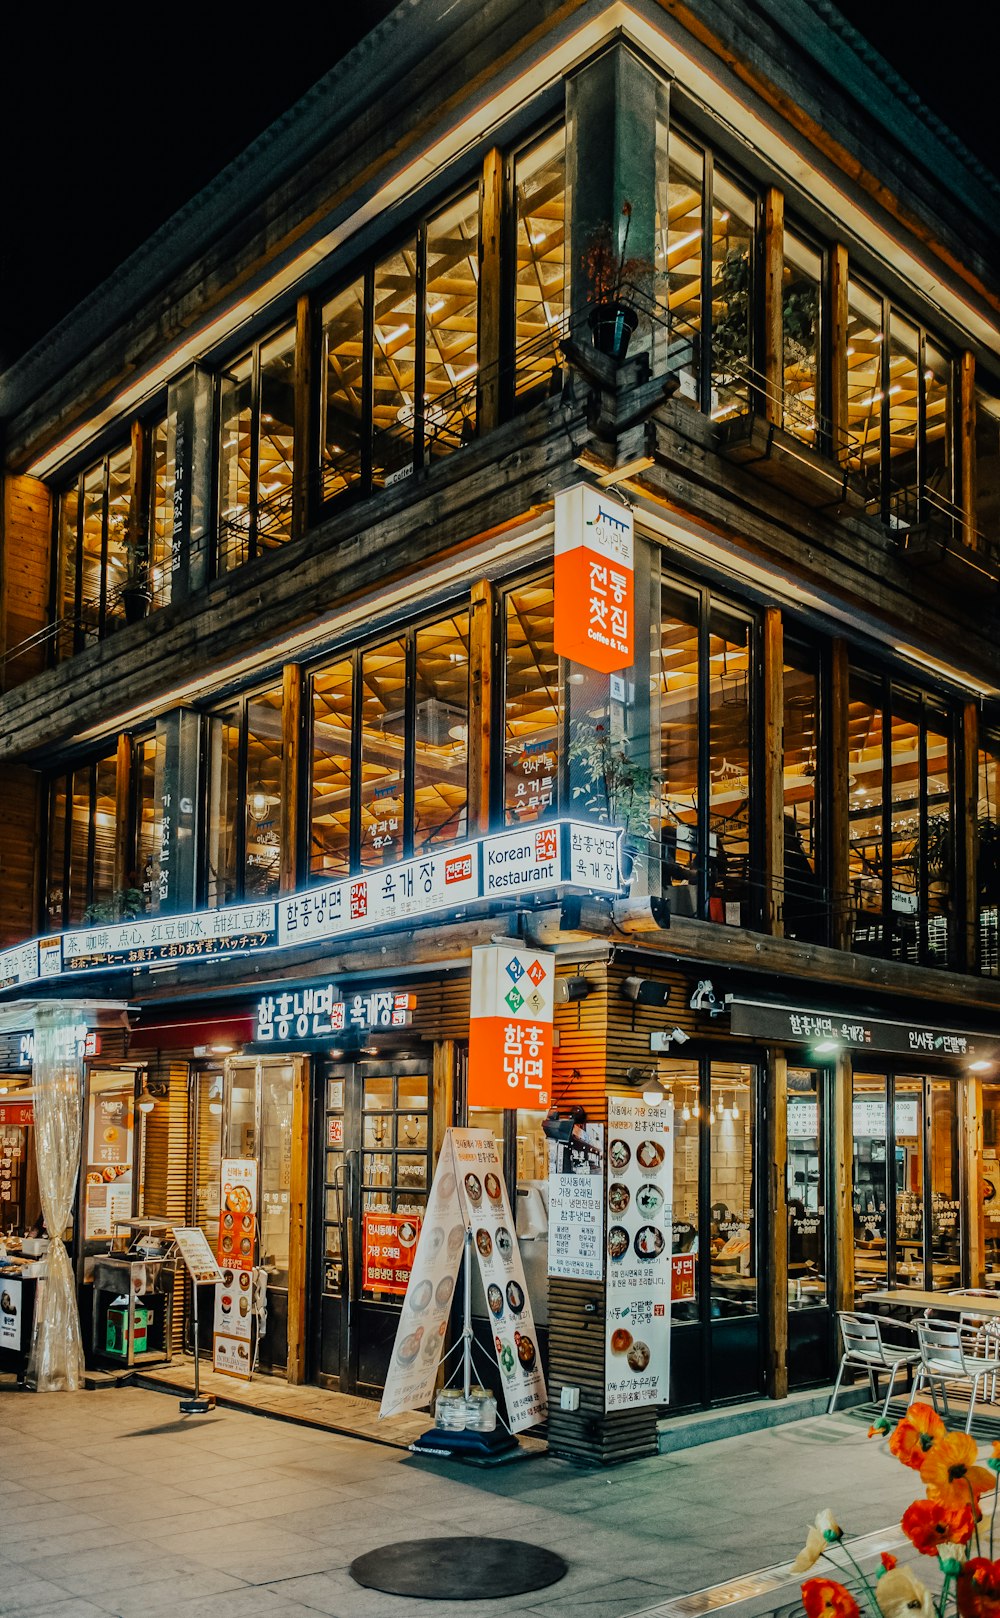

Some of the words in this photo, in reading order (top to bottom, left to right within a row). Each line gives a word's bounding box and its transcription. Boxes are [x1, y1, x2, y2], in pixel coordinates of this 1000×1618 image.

[393, 466, 413, 483] Coffee
[588, 561, 628, 603] 전통
[588, 597, 628, 639] 찻집
[587, 628, 610, 646] Coffee
[610, 638, 617, 649] &
[617, 640, 629, 654] Tea
[522, 753, 554, 775] 인사마루
[514, 776, 553, 797] 요거트
[514, 792, 553, 813] 스무디
[368, 817, 398, 836] 생과일
[372, 834, 393, 849] 쥬스
[572, 833, 615, 857] 함흥냉면
[488, 845, 531, 865] Korean
[488, 863, 554, 889] Restaurant
[576, 859, 614, 880] 육개장
[381, 861, 435, 902] 육개장
[445, 859, 471, 880] 전문점
[287, 888, 341, 931] 함흥냉면
[257, 984, 334, 1041] 함흥냉면
[350, 992, 394, 1028] 육개장
[504, 1023, 544, 1057] 함흥
[789, 1014, 833, 1038] 함흥냉면
[841, 1023, 865, 1043] 육개장
[908, 1031, 934, 1051] 인사동
[942, 1035, 967, 1054] 단팥빵
[503, 1057, 543, 1090] 냉면
[609, 1105, 632, 1116] 사동에서
[635, 1107, 646, 1117] 가장
[648, 1108, 667, 1118] 오래된
[635, 1121, 663, 1132] 함흥냉면
[560, 1176, 592, 1187] 인사동에서
[558, 1187, 571, 1198] 가장
[574, 1188, 593, 1198] 오래된
[551, 1198, 563, 1208] 한식
[569, 1199, 600, 1210] 냉면전문점
[560, 1210, 591, 1222] 함흥냉면
[367, 1224, 398, 1237] 인사동에서
[367, 1245, 380, 1257] 가장
[382, 1246, 400, 1259] 오래된
[367, 1267, 393, 1281] 함흥냉면
[395, 1269, 411, 1283] 전문
[673, 1260, 692, 1275] 냉면
[630, 1300, 653, 1313] 단팥빵
[630, 1312, 653, 1325] 경주빵
[620, 1375, 659, 1390] 유기농우리밀
